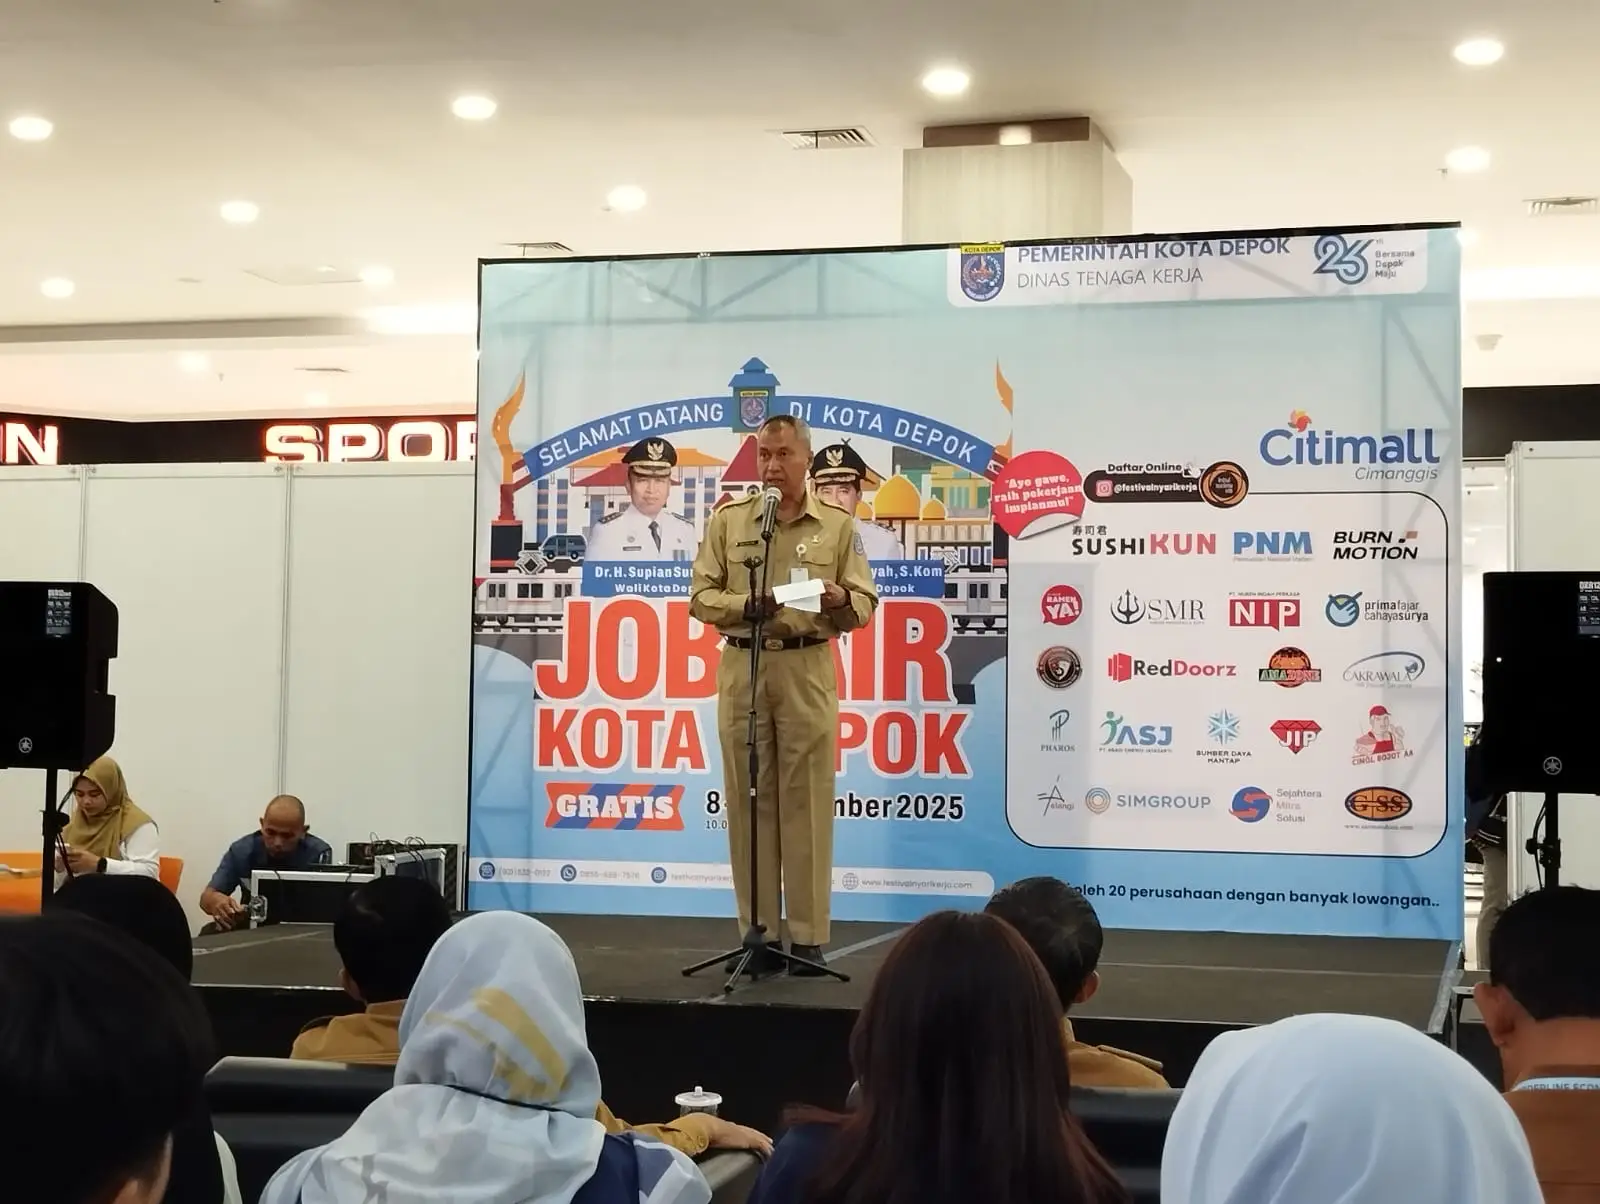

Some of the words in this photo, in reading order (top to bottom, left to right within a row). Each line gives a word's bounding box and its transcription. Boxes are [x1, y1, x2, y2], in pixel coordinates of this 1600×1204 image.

[1018, 243, 1148, 263] PEMERINTAH
[1155, 239, 1213, 258] KOTA
[1219, 237, 1290, 257] DEPOK
[1018, 272, 1070, 289] DINAS
[1077, 270, 1147, 286] TENAGA
[1153, 267, 1204, 284] KERJA
[539, 415, 632, 467] SELAMAT
[639, 403, 724, 431] DATANG
[789, 401, 811, 421] DI
[823, 405, 883, 433] KOTA
[894, 418, 977, 463] DEPOK
[1259, 428, 1440, 466] Citimall
[1108, 463, 1143, 472] Daftar
[1146, 463, 1182, 472] Online
[1354, 466, 1438, 483] Cimanggis
[995, 491, 1020, 502] raih
[1233, 531, 1313, 554] PNM
[1333, 532, 1392, 544] BURN
[1333, 547, 1418, 559] MOTION
[871, 565, 898, 579] yah,
[876, 583, 915, 595] Depok
[1046, 600, 1080, 619] YA!
[1148, 599, 1207, 620] SMR
[1234, 601, 1297, 626] NIP
[536, 600, 718, 701] JOB
[836, 600, 953, 702] IR
[1133, 659, 1237, 677] RedDoorz
[538, 707, 706, 770] KOTA
[833, 711, 970, 775] POK
[1116, 725, 1173, 745] ASJ
[1280, 730, 1319, 747] JIP
[1116, 794, 1212, 809] SIMGROUP
[1276, 788, 1322, 799] Sejahtera
[555, 794, 674, 820] GRATIS
[834, 792, 892, 818] mber
[897, 794, 964, 820] 2025
[706, 820, 727, 829] 10.0
[1276, 814, 1306, 823] Solusi
[1109, 884, 1126, 897] 20
[1129, 886, 1222, 901] perusahaan
[1226, 888, 1286, 905] dengan
[1289, 890, 1349, 907] banyak
[1352, 891, 1440, 909] lowongan..
